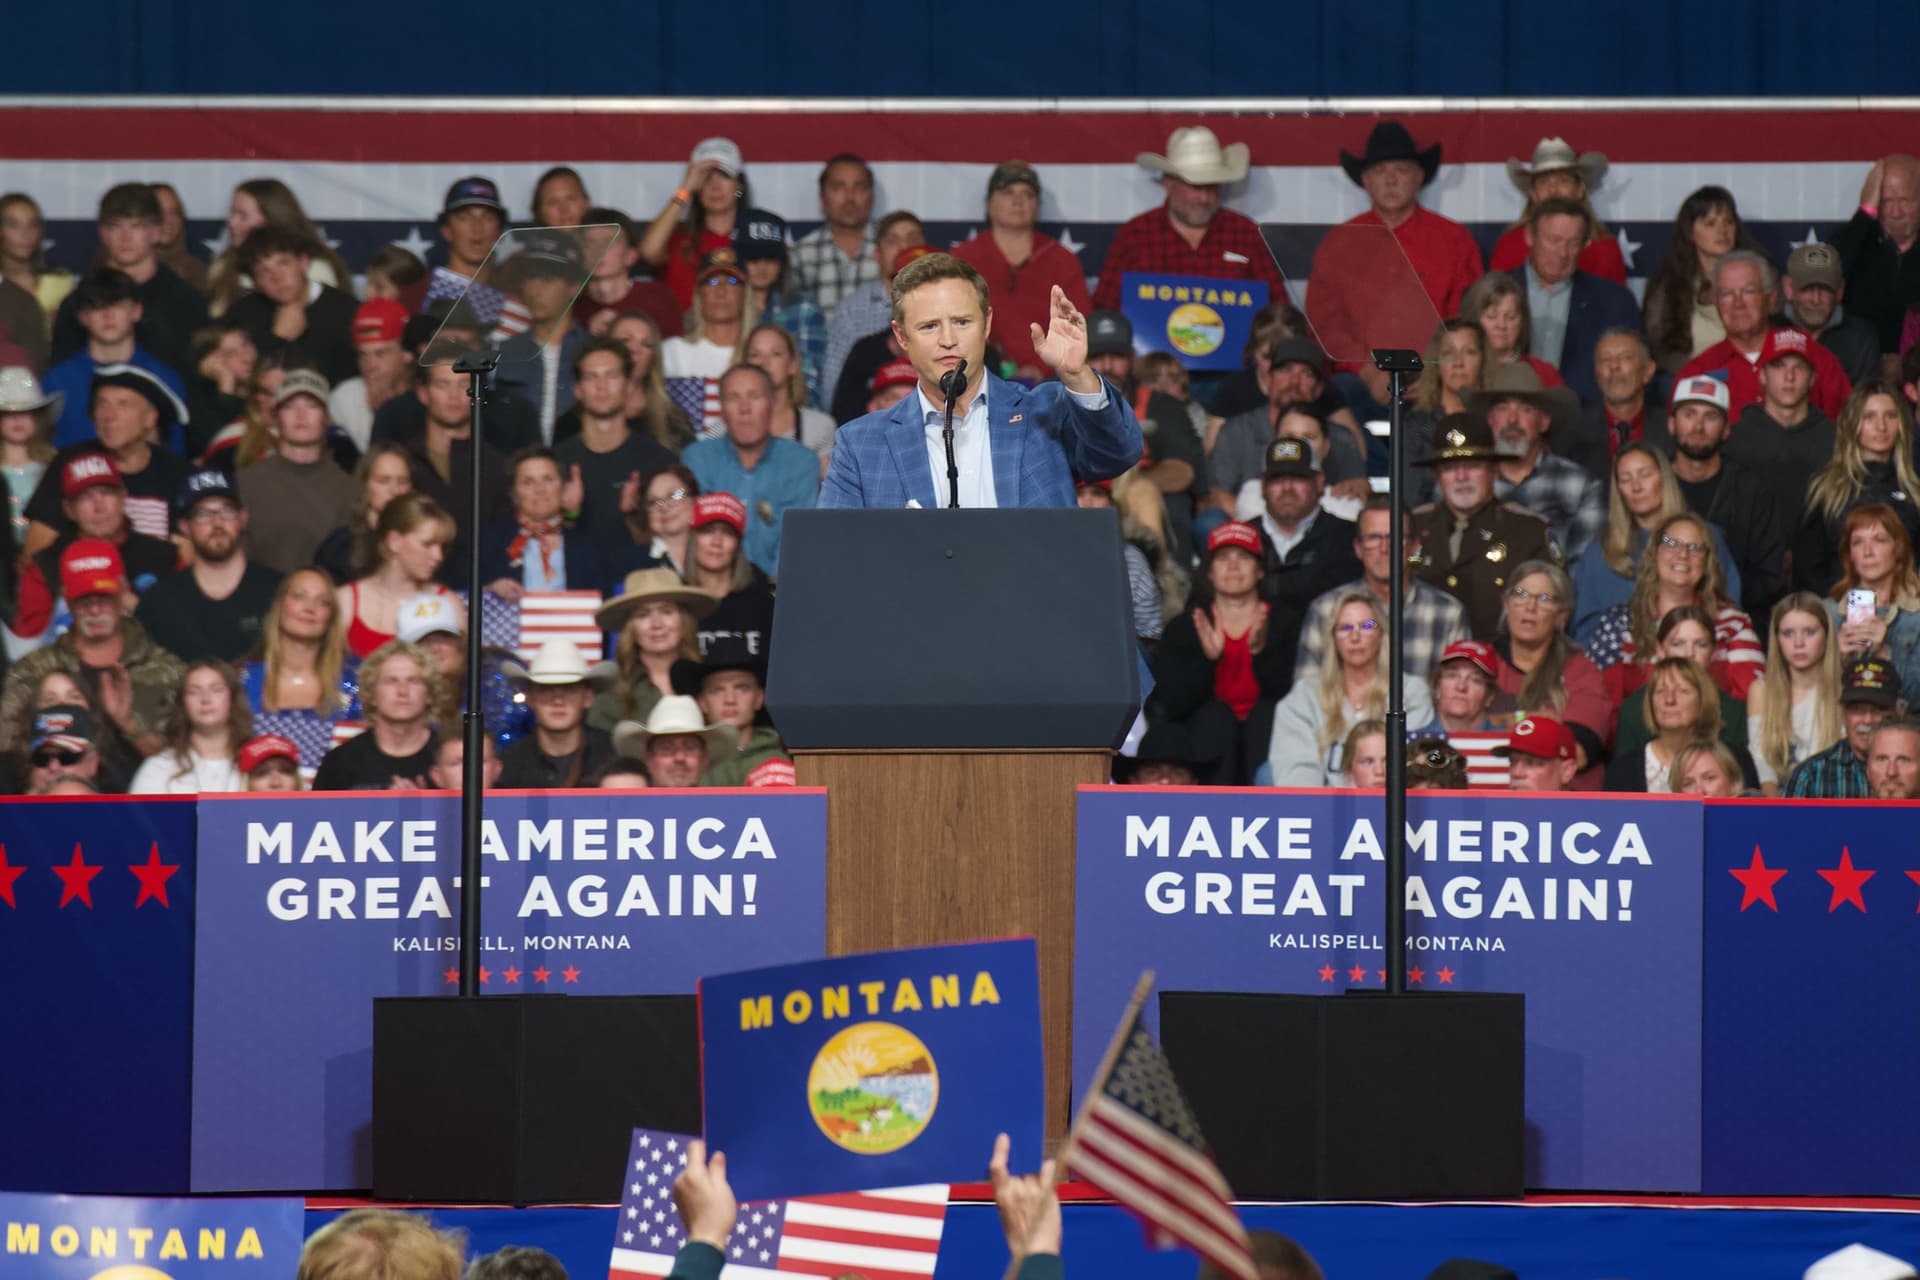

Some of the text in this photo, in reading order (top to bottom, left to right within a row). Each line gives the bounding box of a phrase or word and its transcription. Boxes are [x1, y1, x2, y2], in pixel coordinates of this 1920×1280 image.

[1138, 285, 1253, 308] MONTANA
[415, 599, 442, 618] 47
[246, 817, 777, 864] MAKE AMERICA
[1125, 815, 1653, 866] MAKE AMERICA
[266, 873, 757, 921] GREA AGAIN!
[1144, 871, 1633, 922] GREAT AGAIN!
[393, 934, 631, 953] KALISLL, MONTANA
[740, 971, 1000, 1030] MONTANA
[6, 1222, 264, 1261] MONTANA
